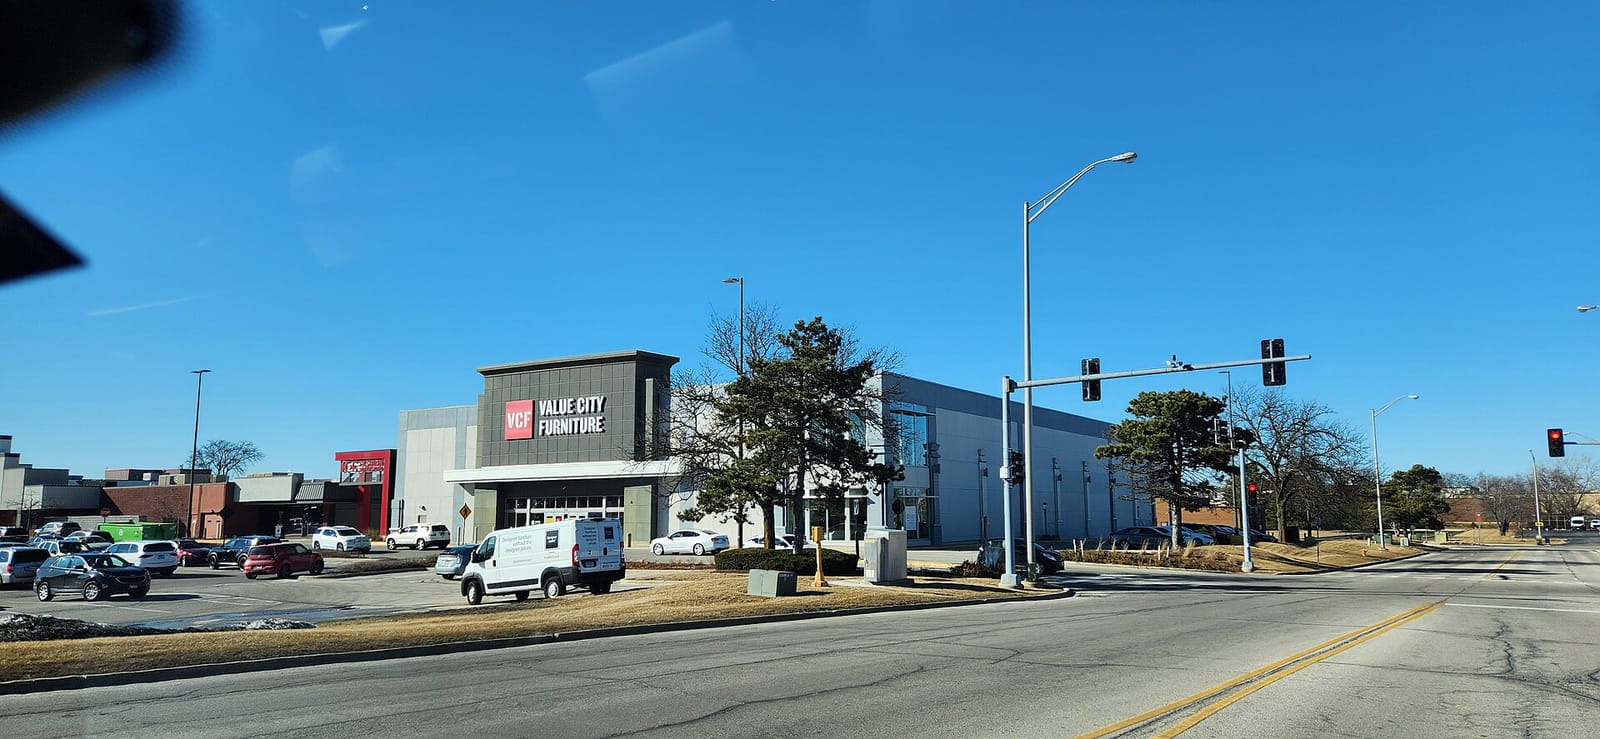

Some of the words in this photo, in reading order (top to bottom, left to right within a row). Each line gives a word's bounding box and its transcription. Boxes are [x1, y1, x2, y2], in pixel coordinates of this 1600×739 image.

[539, 398, 574, 416] VALUE
[577, 395, 604, 414] CITY
[507, 411, 532, 429] VCF
[539, 416, 603, 436] FURNITURE
